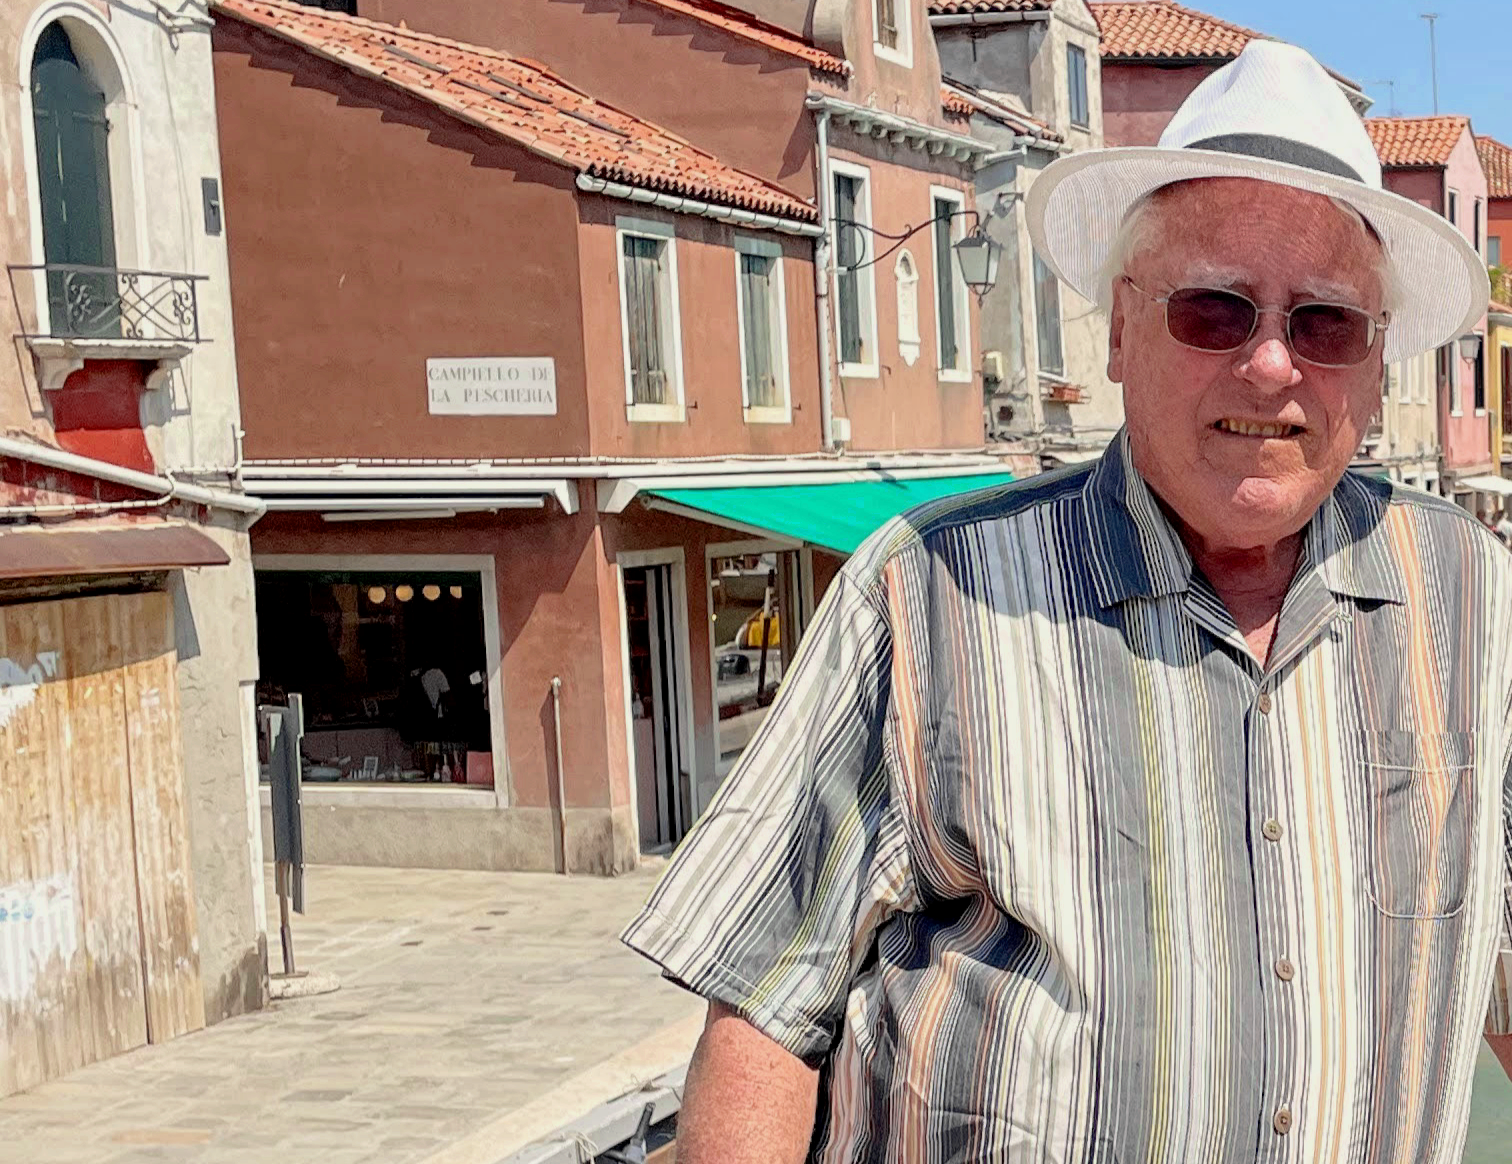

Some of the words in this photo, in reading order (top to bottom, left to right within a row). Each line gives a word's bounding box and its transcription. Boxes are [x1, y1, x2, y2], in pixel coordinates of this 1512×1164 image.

[428, 366, 520, 381] CAMPIELLO
[431, 388, 451, 403] LA
[463, 388, 553, 403] PESCHERIA
